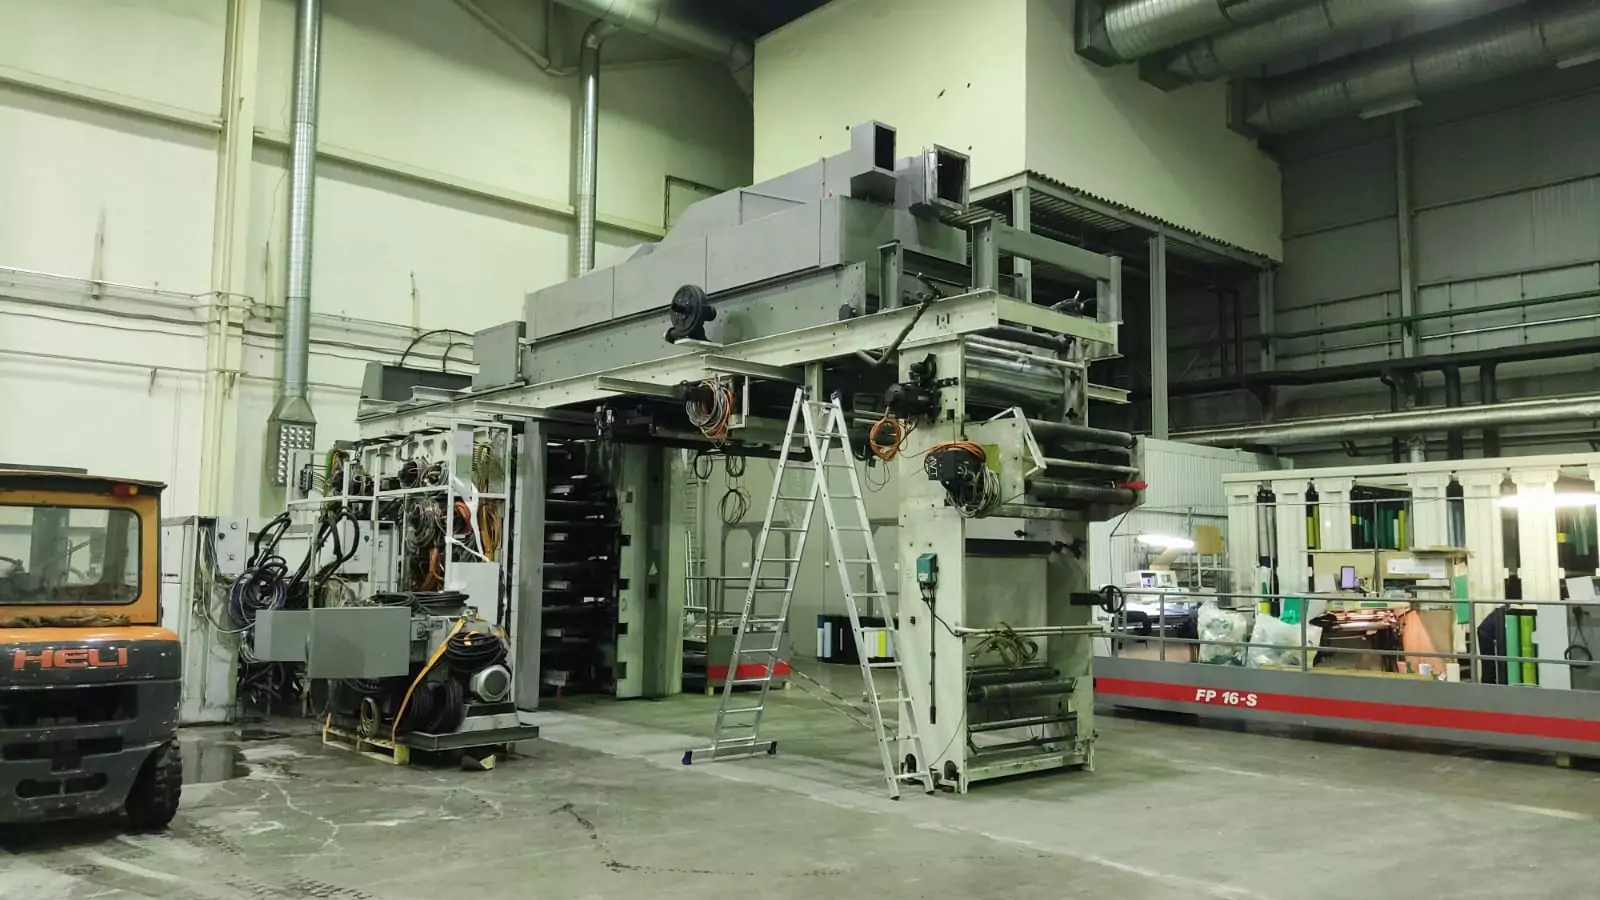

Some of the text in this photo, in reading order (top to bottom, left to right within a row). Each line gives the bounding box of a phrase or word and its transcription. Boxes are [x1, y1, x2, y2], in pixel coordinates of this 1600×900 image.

[13, 647, 128, 671] HELI
[1195, 688, 1258, 707] FP 16-S
